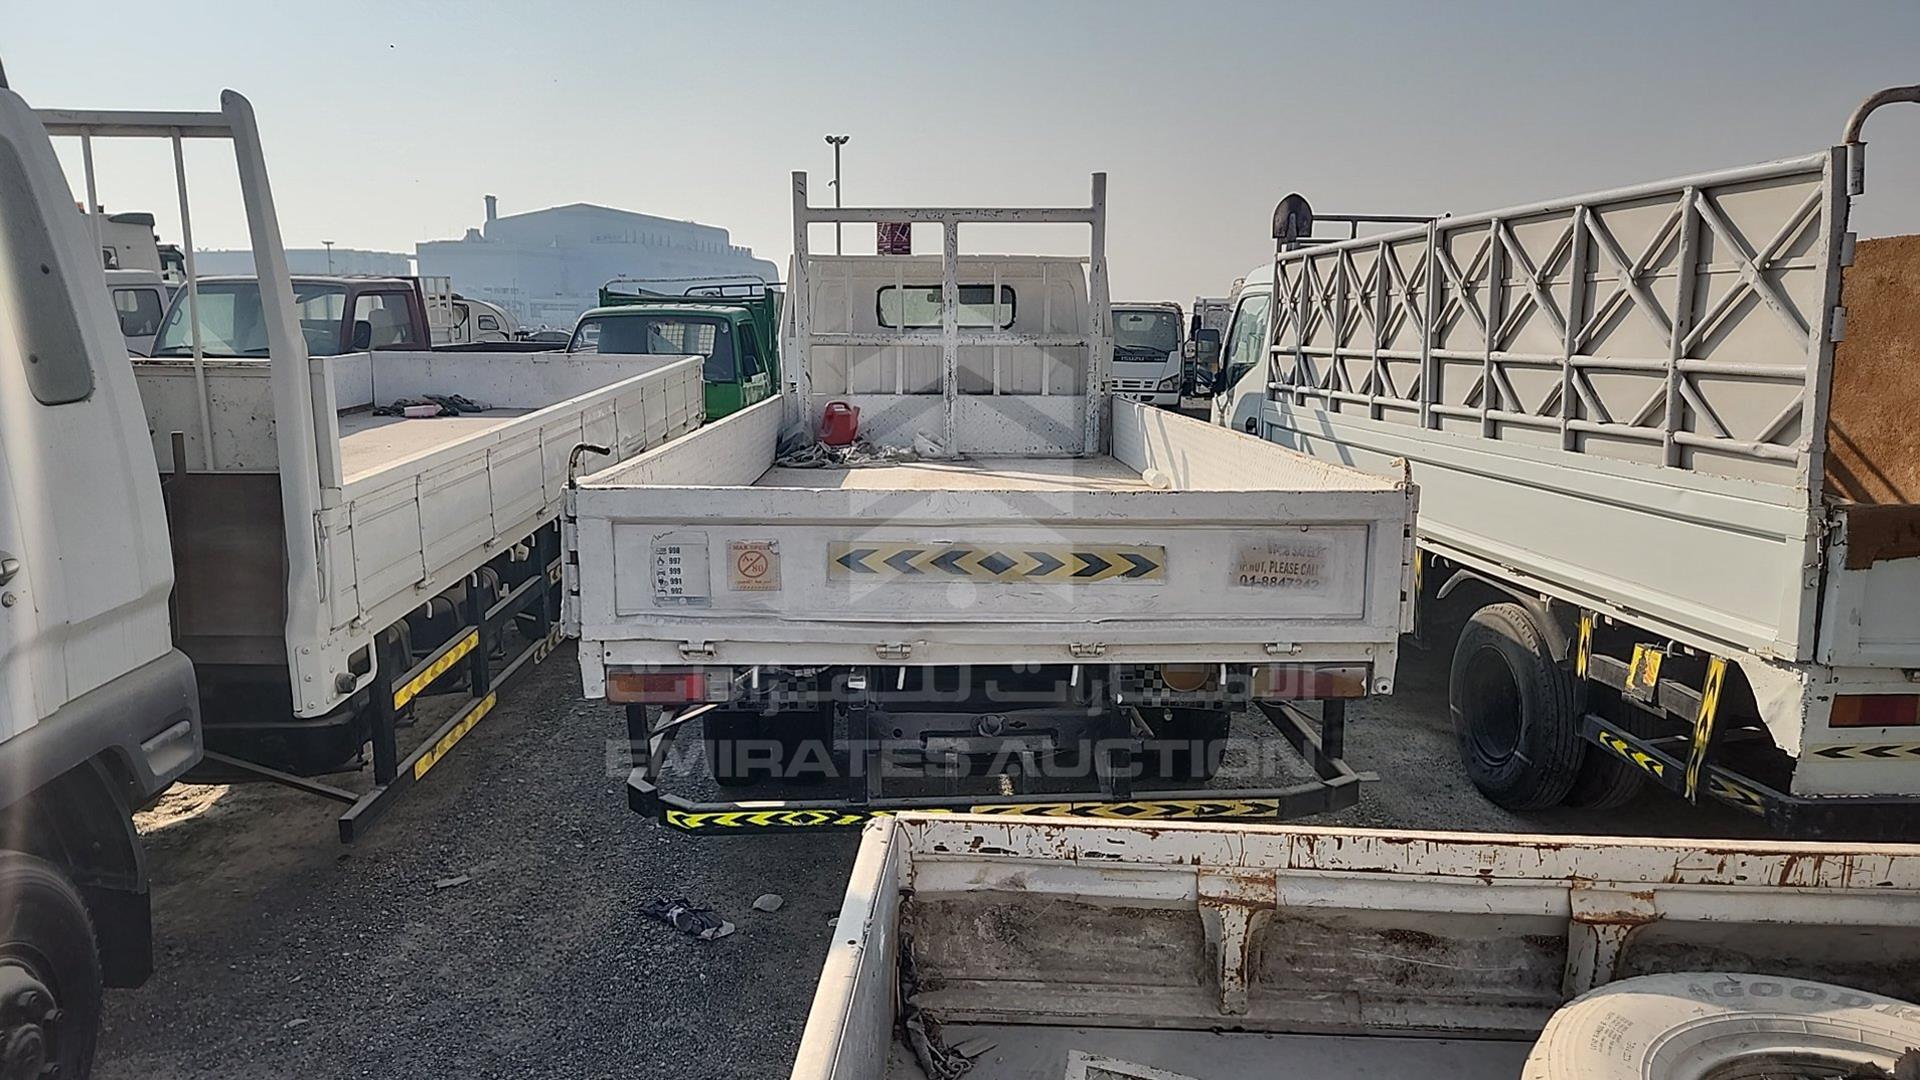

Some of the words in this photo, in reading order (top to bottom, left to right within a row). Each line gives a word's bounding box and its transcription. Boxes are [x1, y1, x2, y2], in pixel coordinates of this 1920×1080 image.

[669, 557, 681, 565] 997
[669, 567, 681, 575] 999
[1269, 560, 1299, 575] PLEASE
[670, 577, 682, 585] 991
[670, 587, 683, 595] 992
